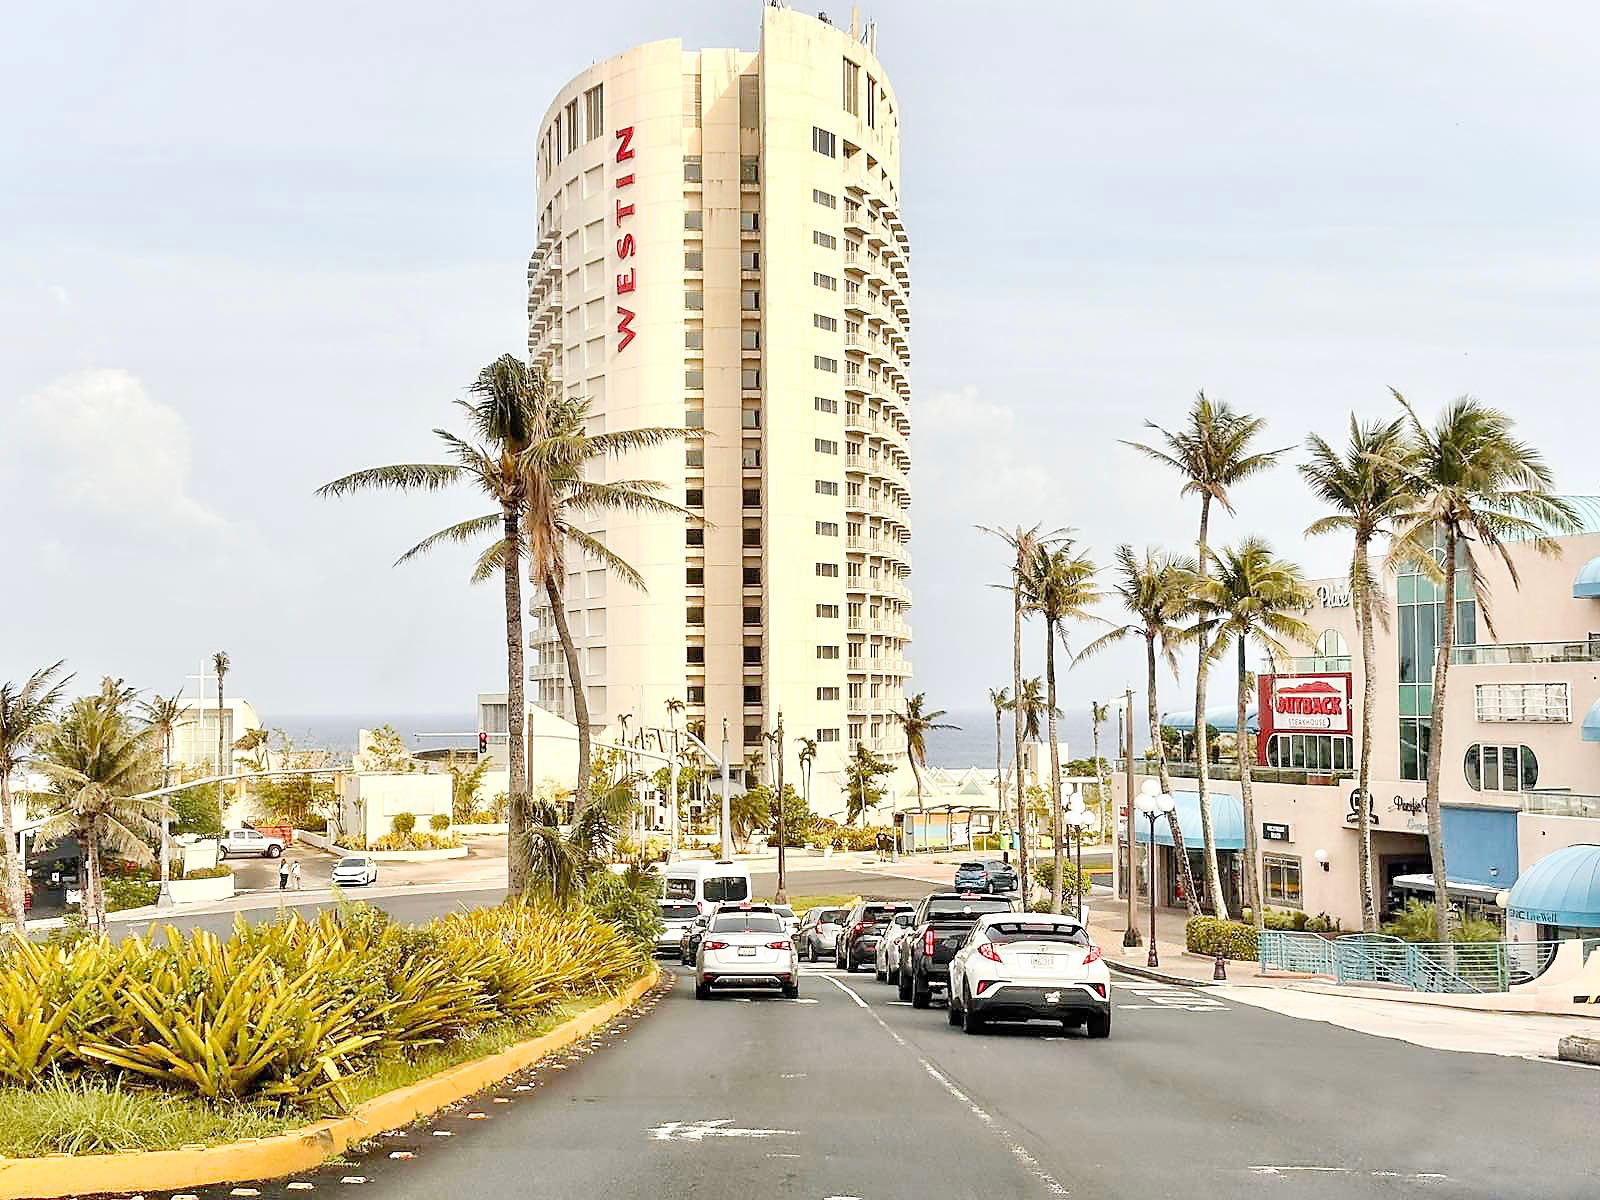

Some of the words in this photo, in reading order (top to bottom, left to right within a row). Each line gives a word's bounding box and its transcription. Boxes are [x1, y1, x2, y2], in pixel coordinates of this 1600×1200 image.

[615, 125, 637, 353] WESTIN
[1276, 696, 1342, 716] OUTBACK
[1288, 718, 1327, 727] STEAKHOUSE
